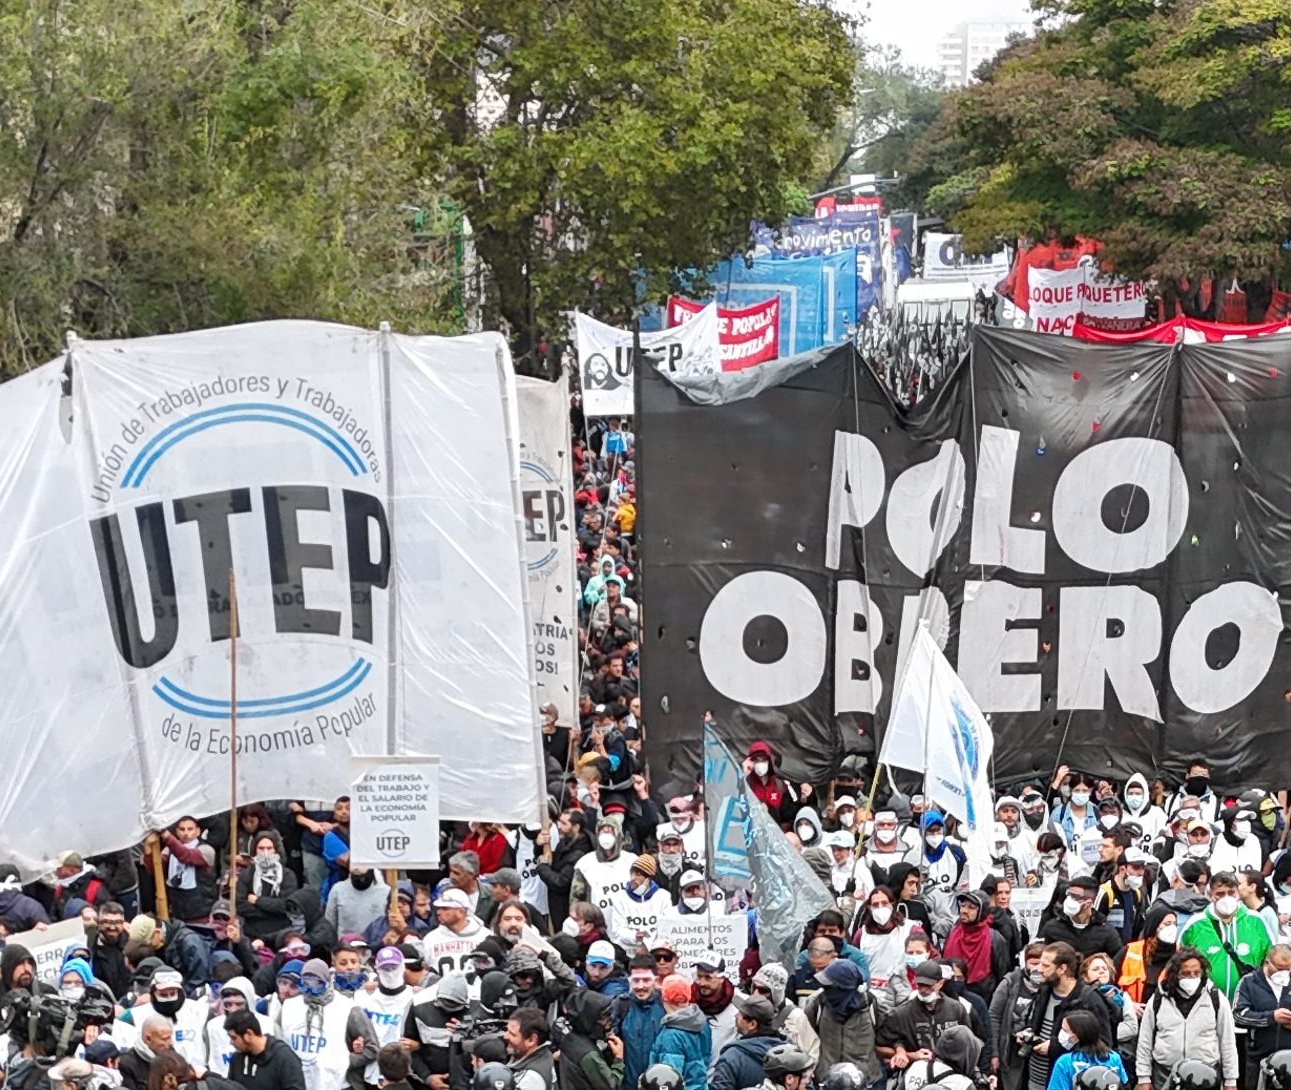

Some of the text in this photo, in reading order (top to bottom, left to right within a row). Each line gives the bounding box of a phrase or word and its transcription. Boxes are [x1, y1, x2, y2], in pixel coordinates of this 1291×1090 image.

[91, 375, 382, 503] Unión de Trabajadores y Trabajadoras
[825, 425, 1189, 578] POLO
[522, 490, 565, 542] EP
[89, 485, 391, 669] UTEP
[162, 692, 378, 755] de la Economía Popular
[363, 774, 423, 782] EN DEFENSA
[378, 784, 421, 792] TRABAJO
[372, 794, 413, 802] SALARIO
[375, 803, 427, 812] ECONOMÍA
[376, 836, 410, 851] UTEP
[670, 925, 732, 935] ALIMENTOS
[290, 1033, 326, 1053] UTEP
